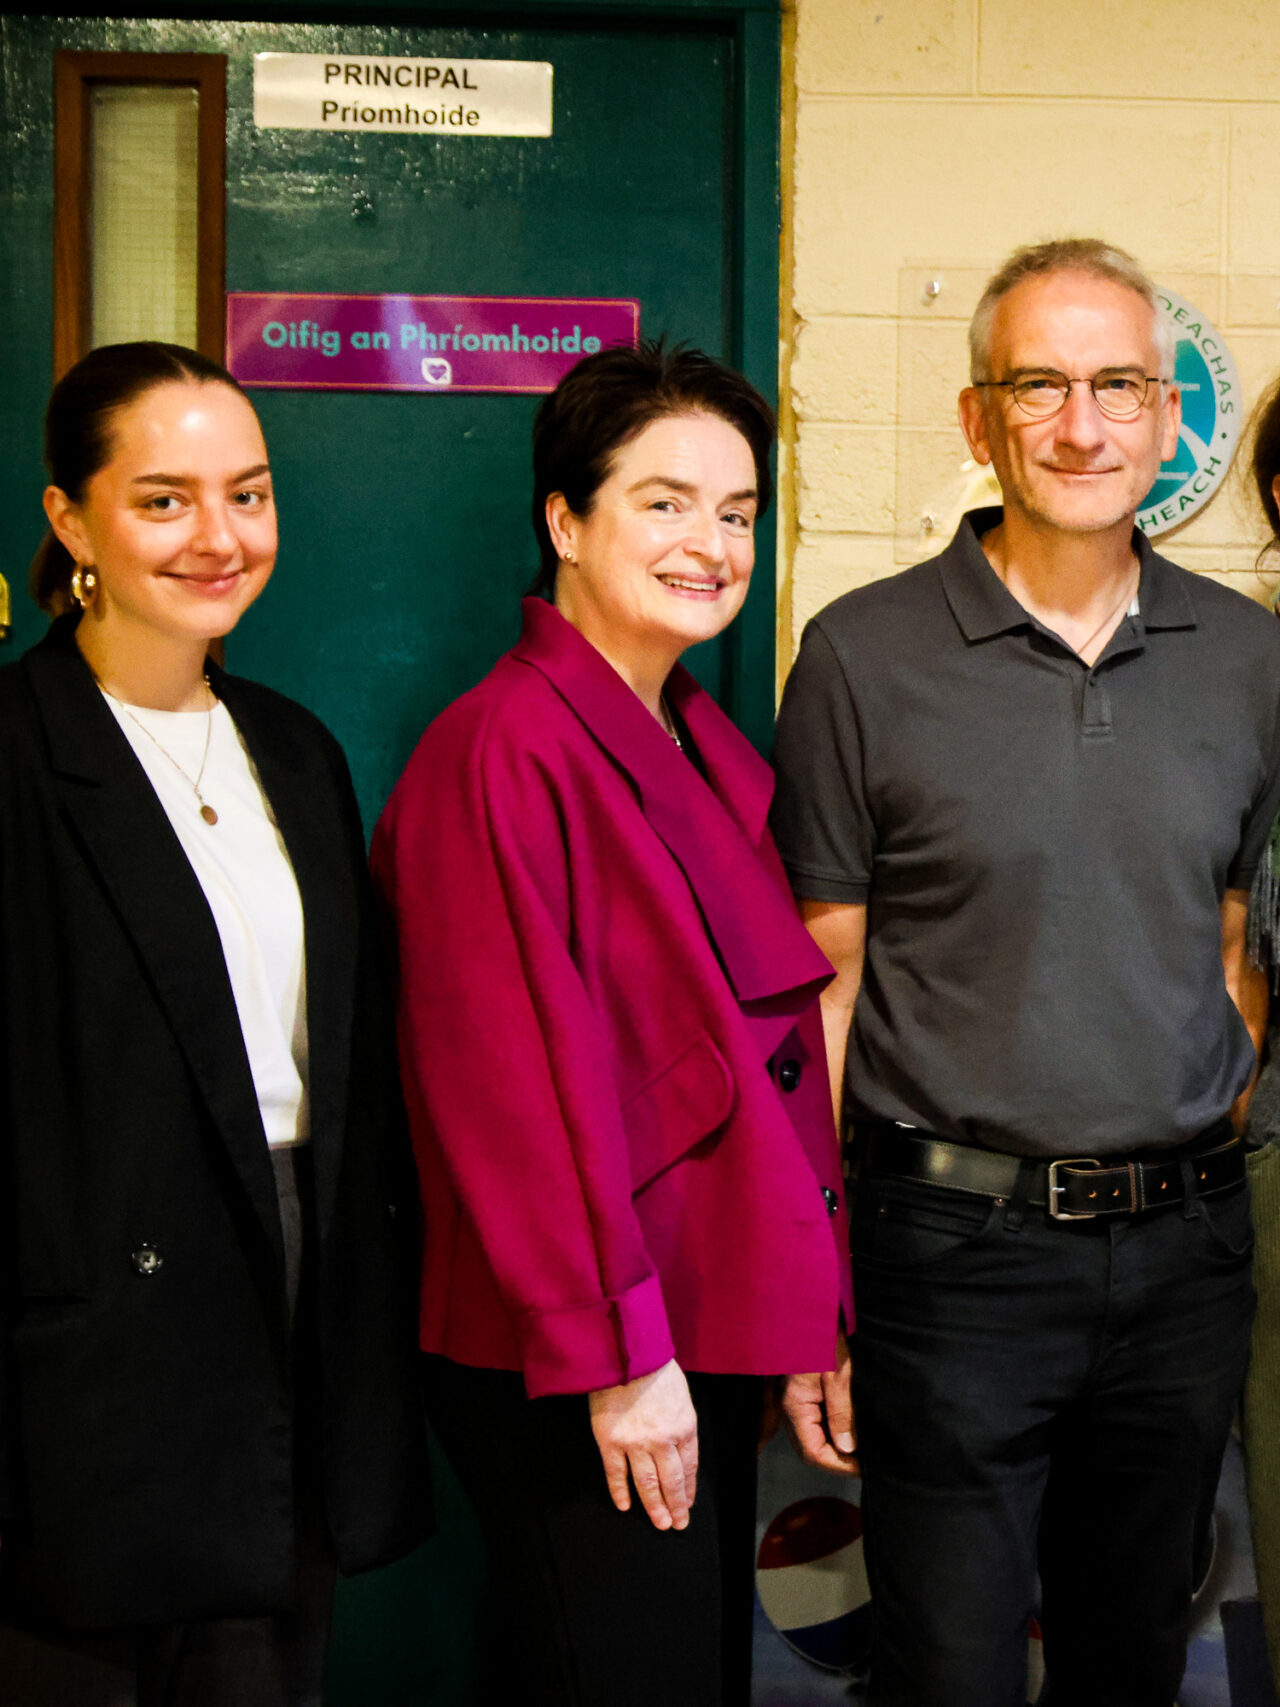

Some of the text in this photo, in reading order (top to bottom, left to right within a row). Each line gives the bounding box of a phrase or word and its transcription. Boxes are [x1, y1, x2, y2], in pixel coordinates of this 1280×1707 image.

[324, 63, 478, 90] PRINCIPAL
[321, 100, 480, 127] Príomhoide
[262, 320, 602, 357] Oifig an Phríomhoide
